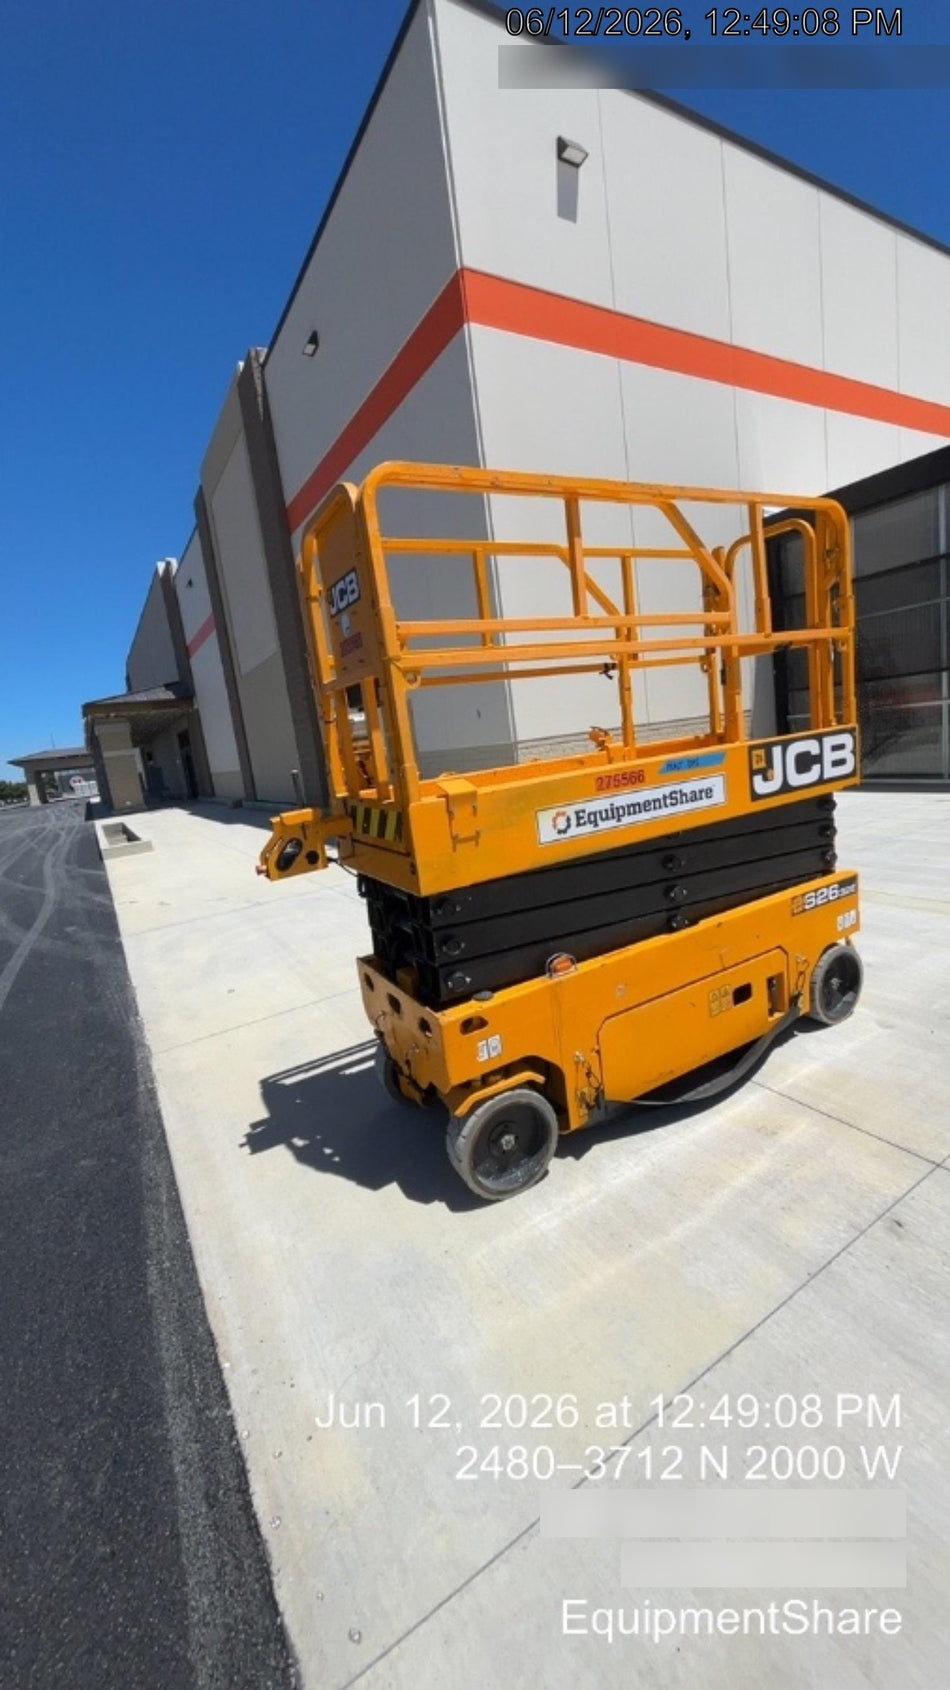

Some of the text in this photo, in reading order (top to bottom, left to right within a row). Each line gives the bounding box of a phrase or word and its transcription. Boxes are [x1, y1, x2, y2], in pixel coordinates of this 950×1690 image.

[330, 571, 359, 615] JCB
[752, 733, 855, 795] JCB
[574, 786, 713, 828] EquipmentShare
